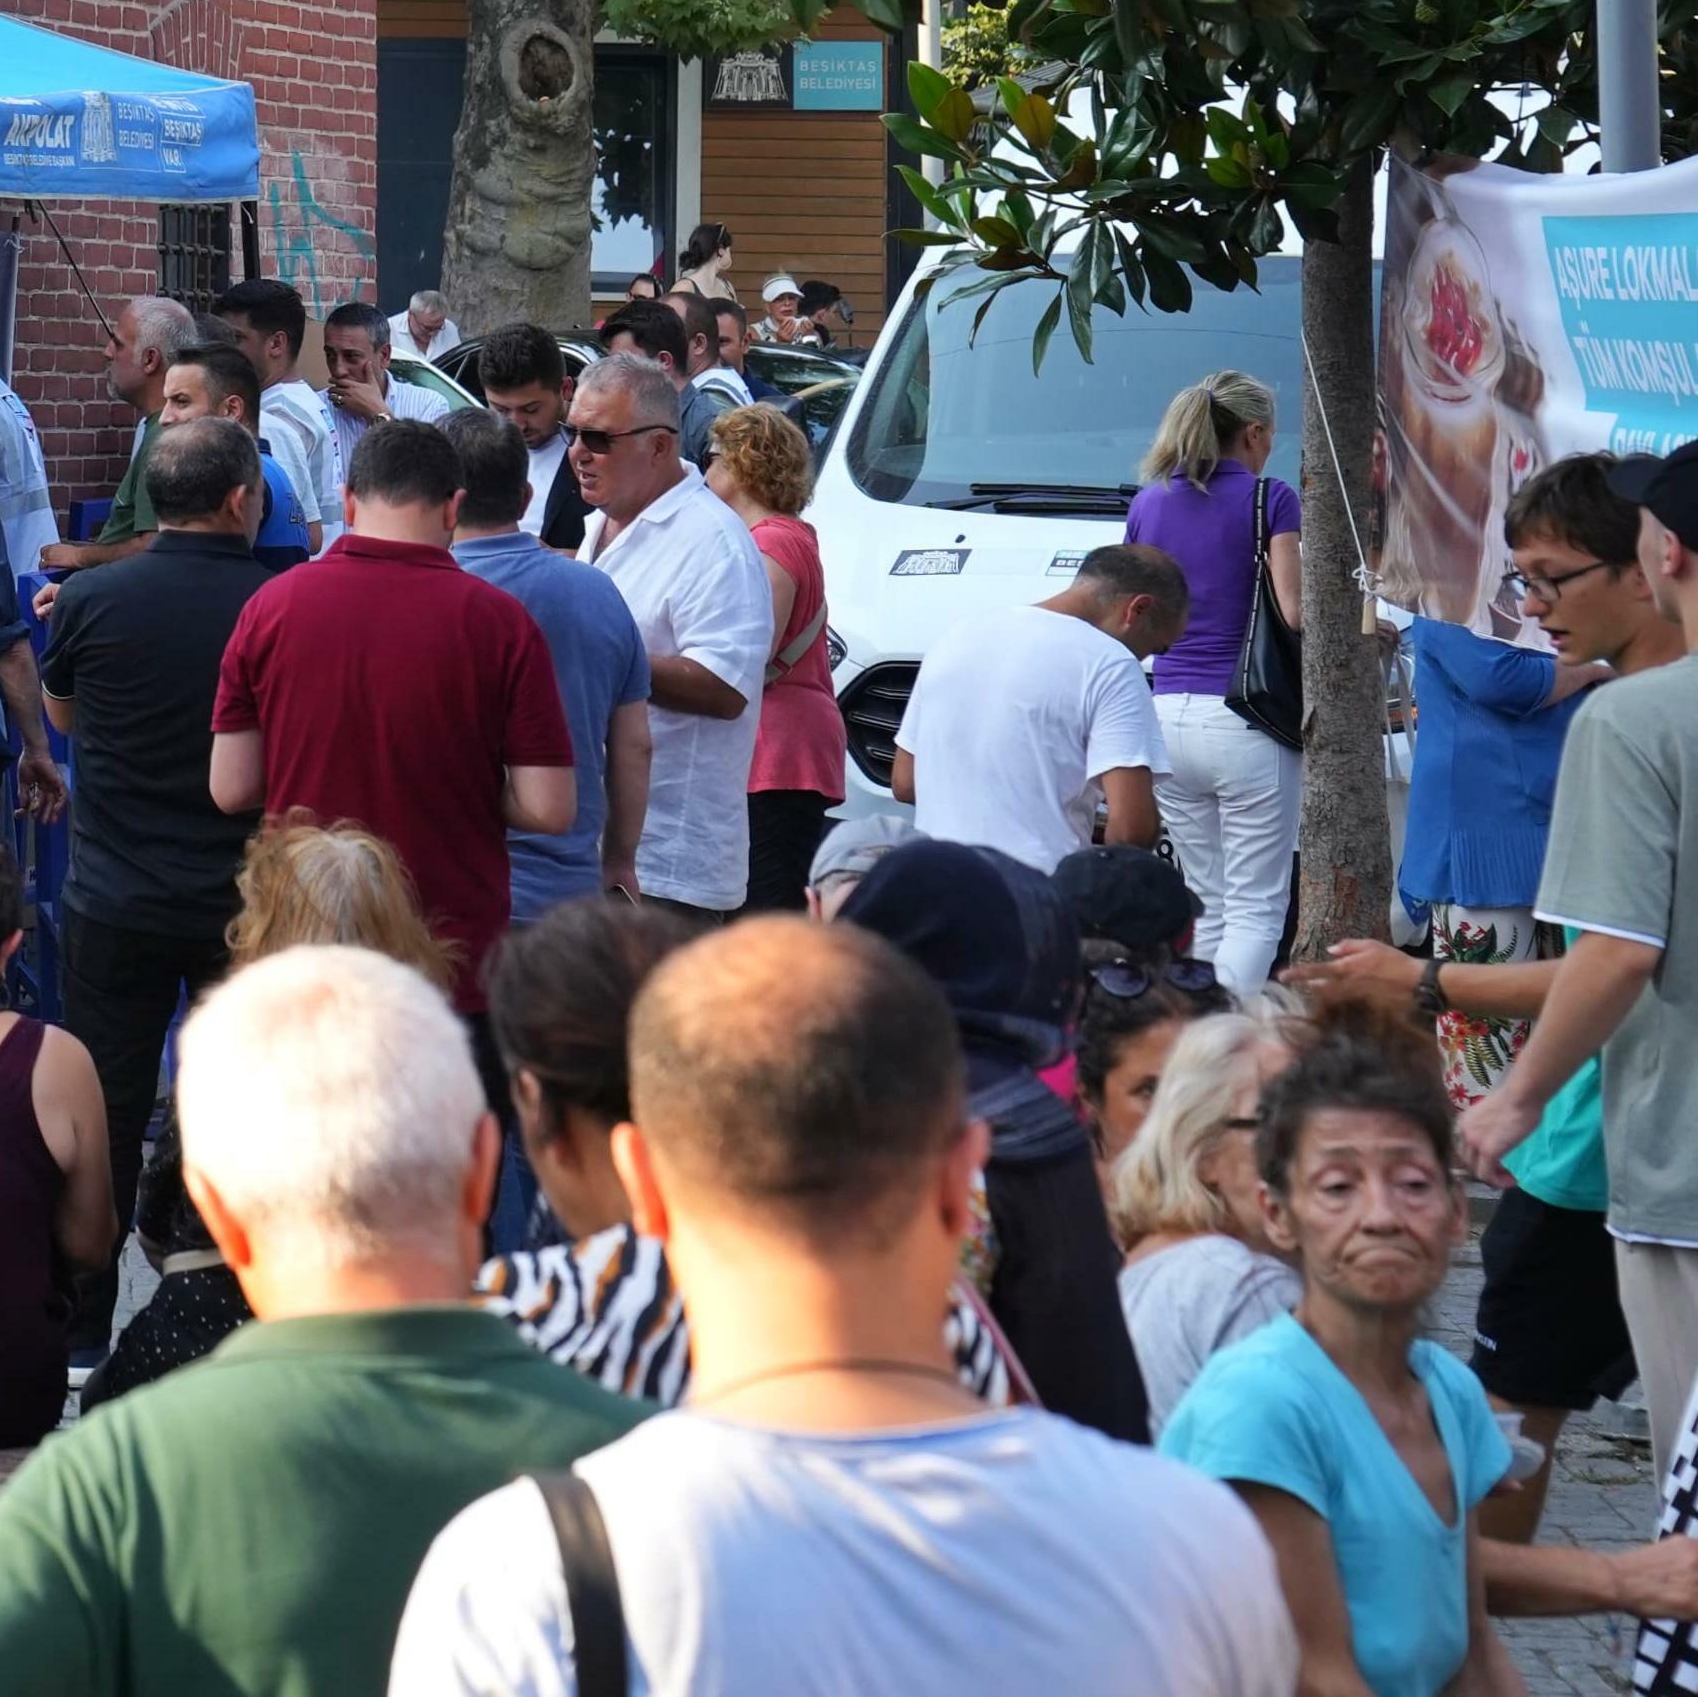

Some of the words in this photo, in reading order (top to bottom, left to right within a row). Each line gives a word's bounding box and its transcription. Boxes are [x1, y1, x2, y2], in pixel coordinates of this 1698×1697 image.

[4, 113, 75, 149] AKPOLAT
[1555, 245, 1614, 311] AŞURE
[1613, 246, 1698, 301] LOKMAL
[1572, 320, 1624, 390] TÜM
[1612, 338, 1698, 407] KOMŞUL
